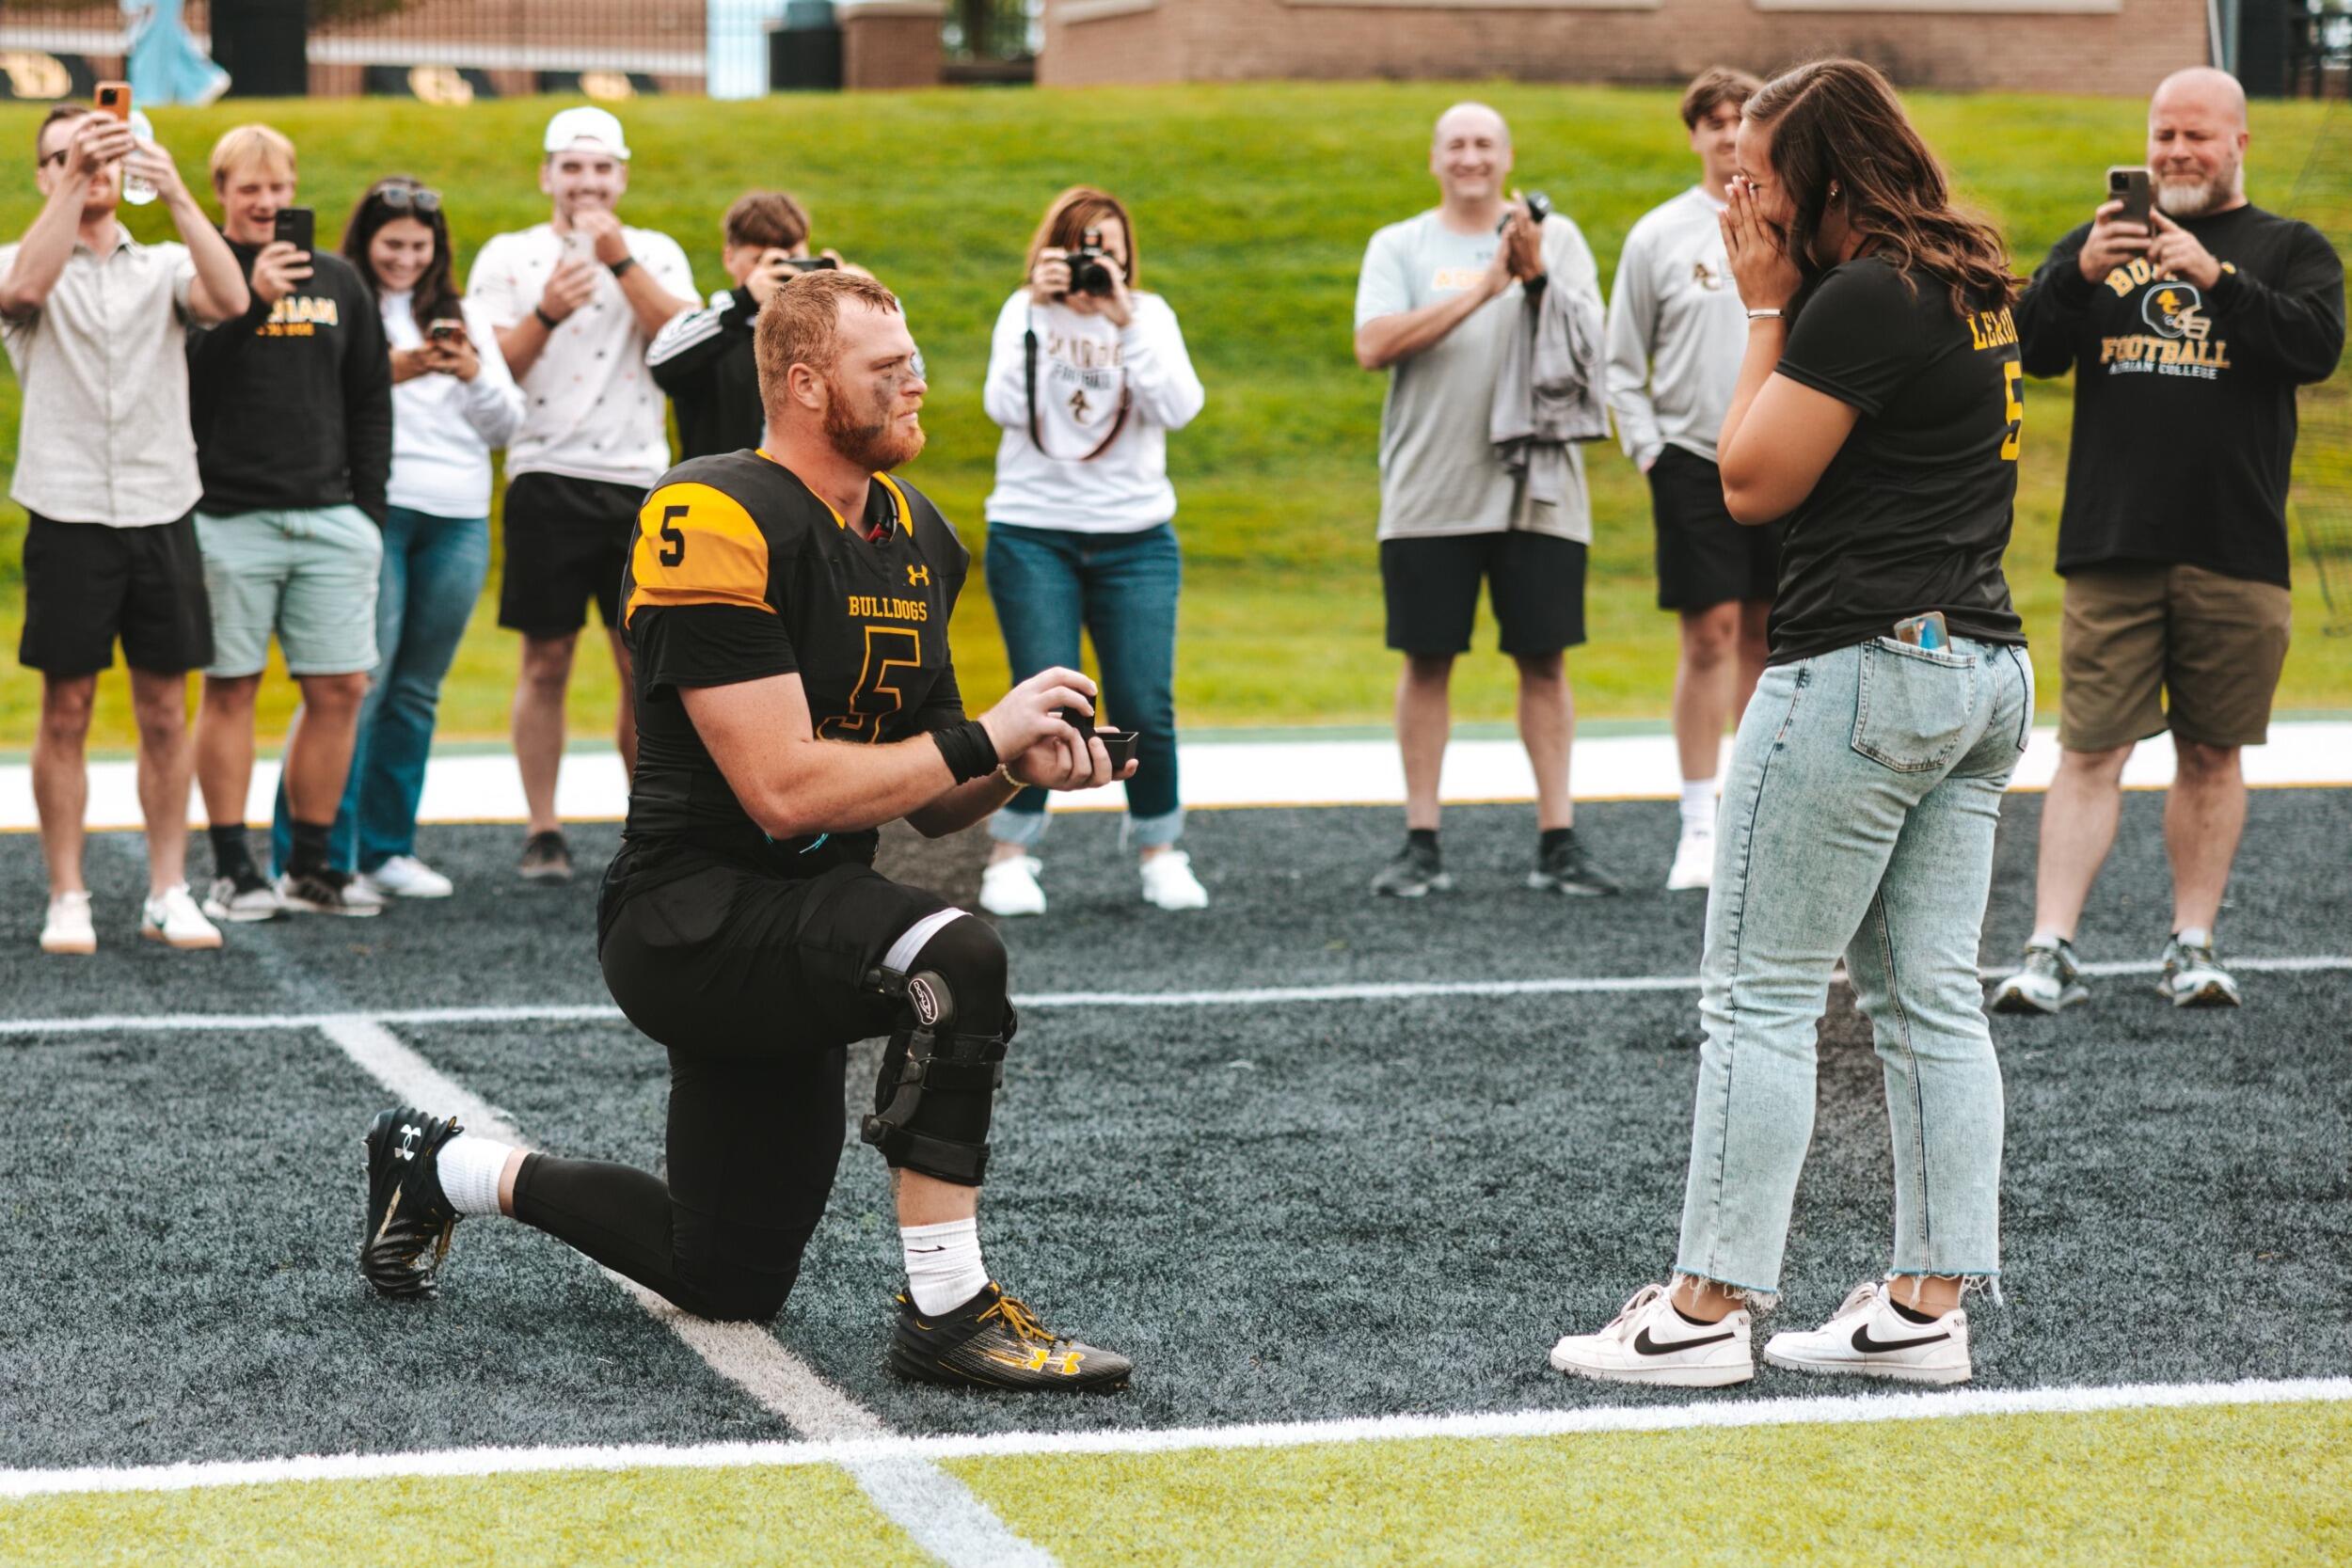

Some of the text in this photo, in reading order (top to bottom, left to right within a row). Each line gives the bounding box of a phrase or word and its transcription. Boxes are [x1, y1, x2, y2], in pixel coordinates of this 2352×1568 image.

[2099, 335, 2232, 370] FOOTBALL
[2000, 360, 2024, 461] 5
[659, 504, 691, 568] 5
[848, 595, 928, 623] BULLDOGS
[816, 625, 921, 745] 5
